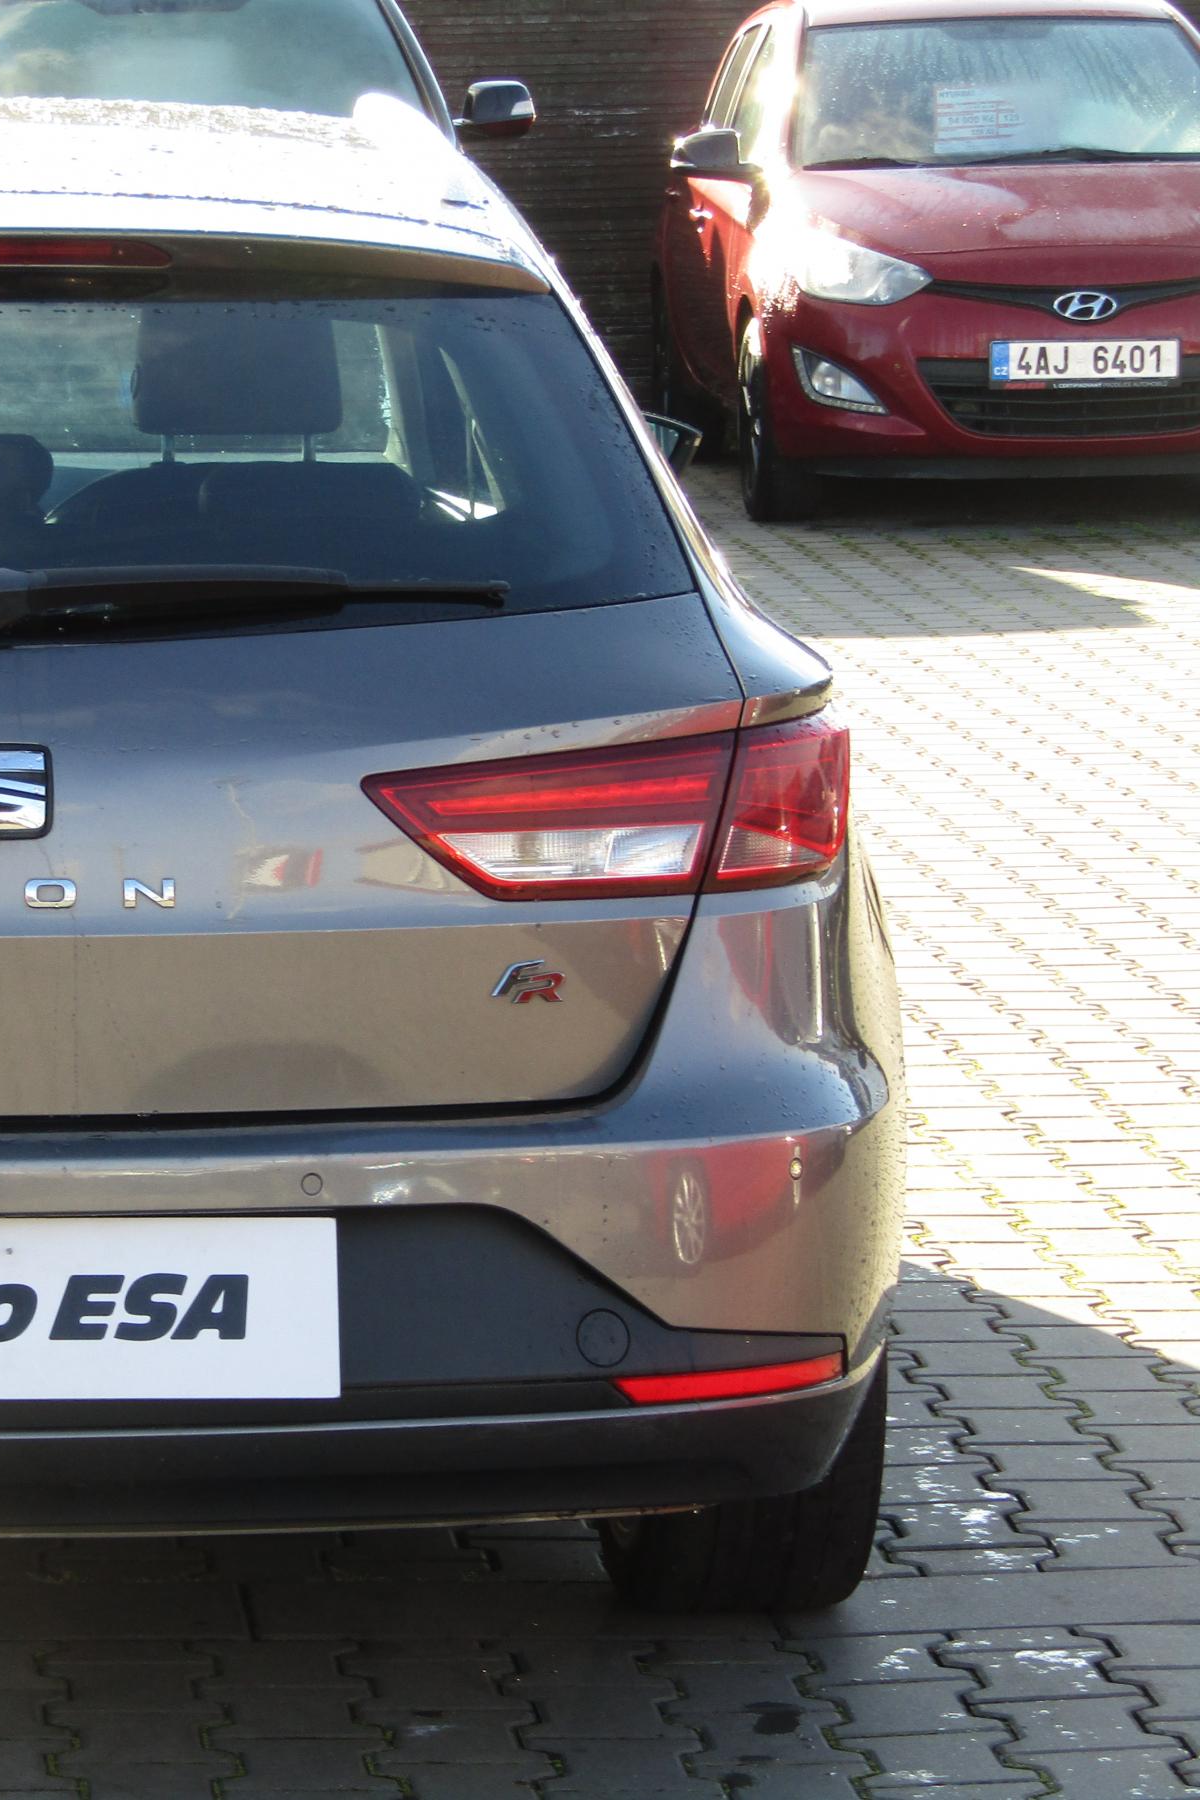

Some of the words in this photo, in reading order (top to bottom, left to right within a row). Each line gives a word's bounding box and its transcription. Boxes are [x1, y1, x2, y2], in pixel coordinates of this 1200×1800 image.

[993, 367, 1008, 376] CZ
[1017, 346, 1069, 375] 4AJ
[1092, 345, 1162, 374] 6401
[491, 959, 565, 1003] FR
[48, 1272, 250, 1341] ESA
